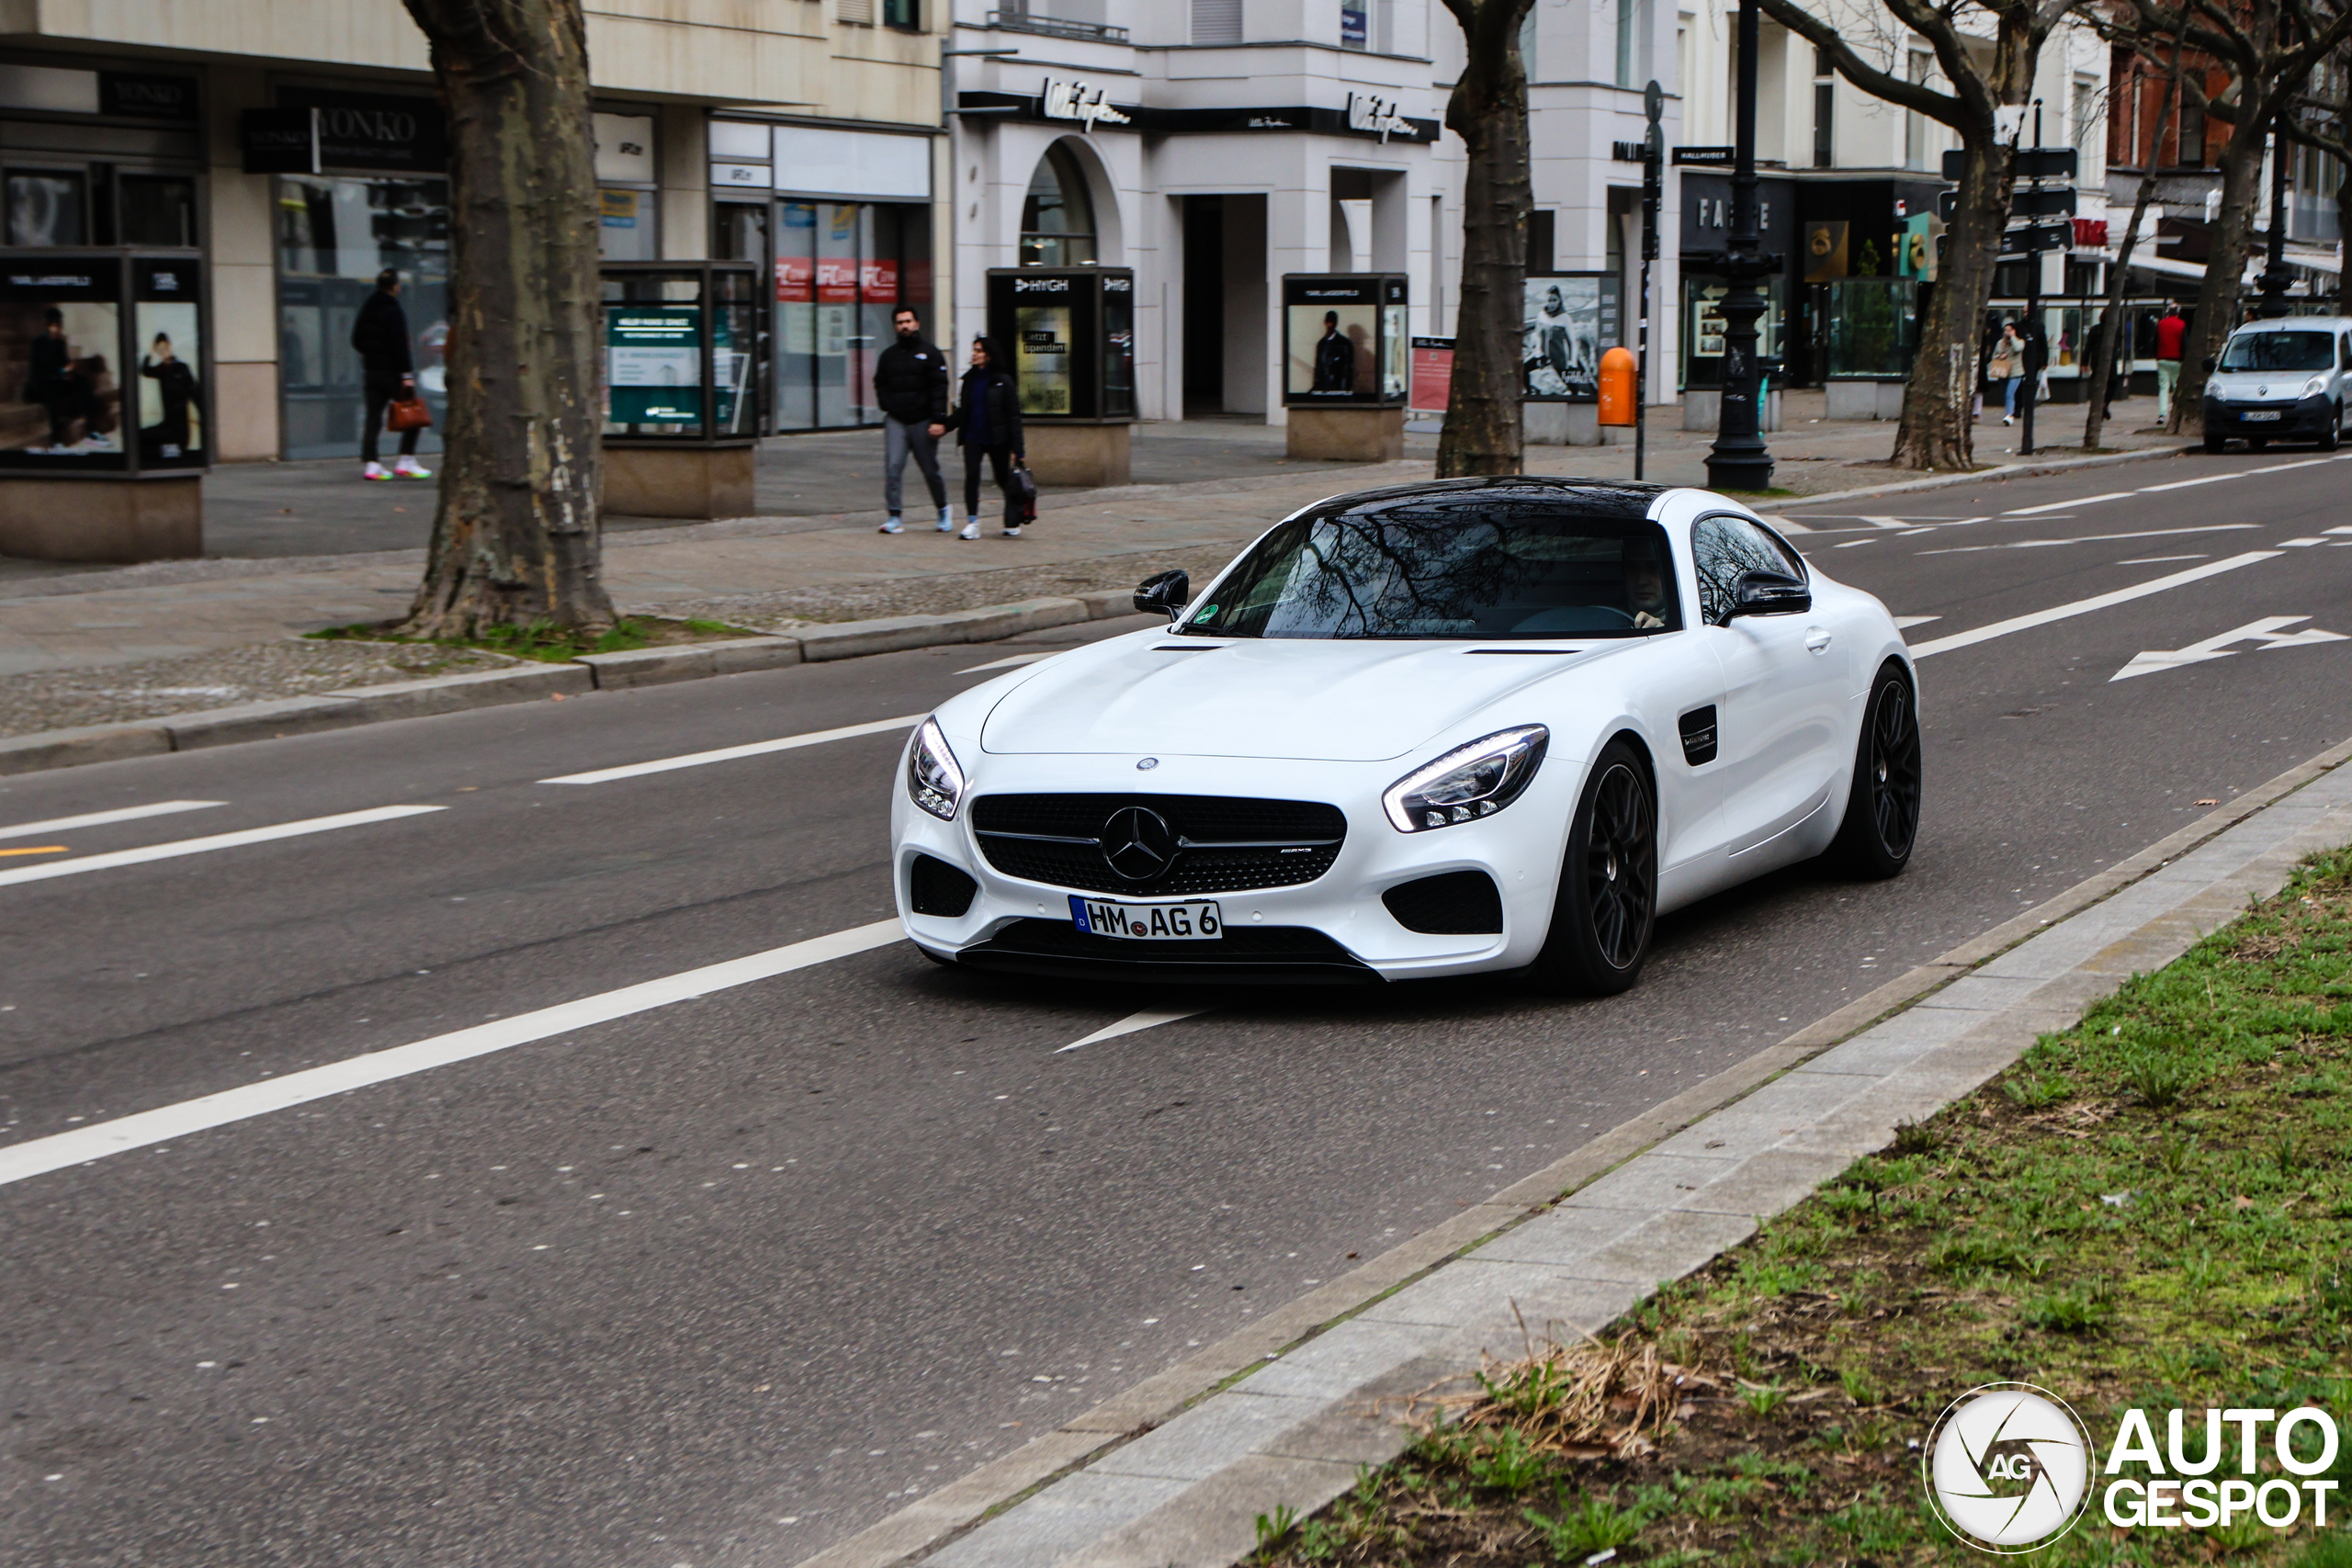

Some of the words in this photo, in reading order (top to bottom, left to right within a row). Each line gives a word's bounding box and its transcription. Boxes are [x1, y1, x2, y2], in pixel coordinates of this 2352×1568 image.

[1088, 903, 1129, 935] HM
[1151, 907, 1193, 936] AG
[1199, 906, 1218, 935] 6
